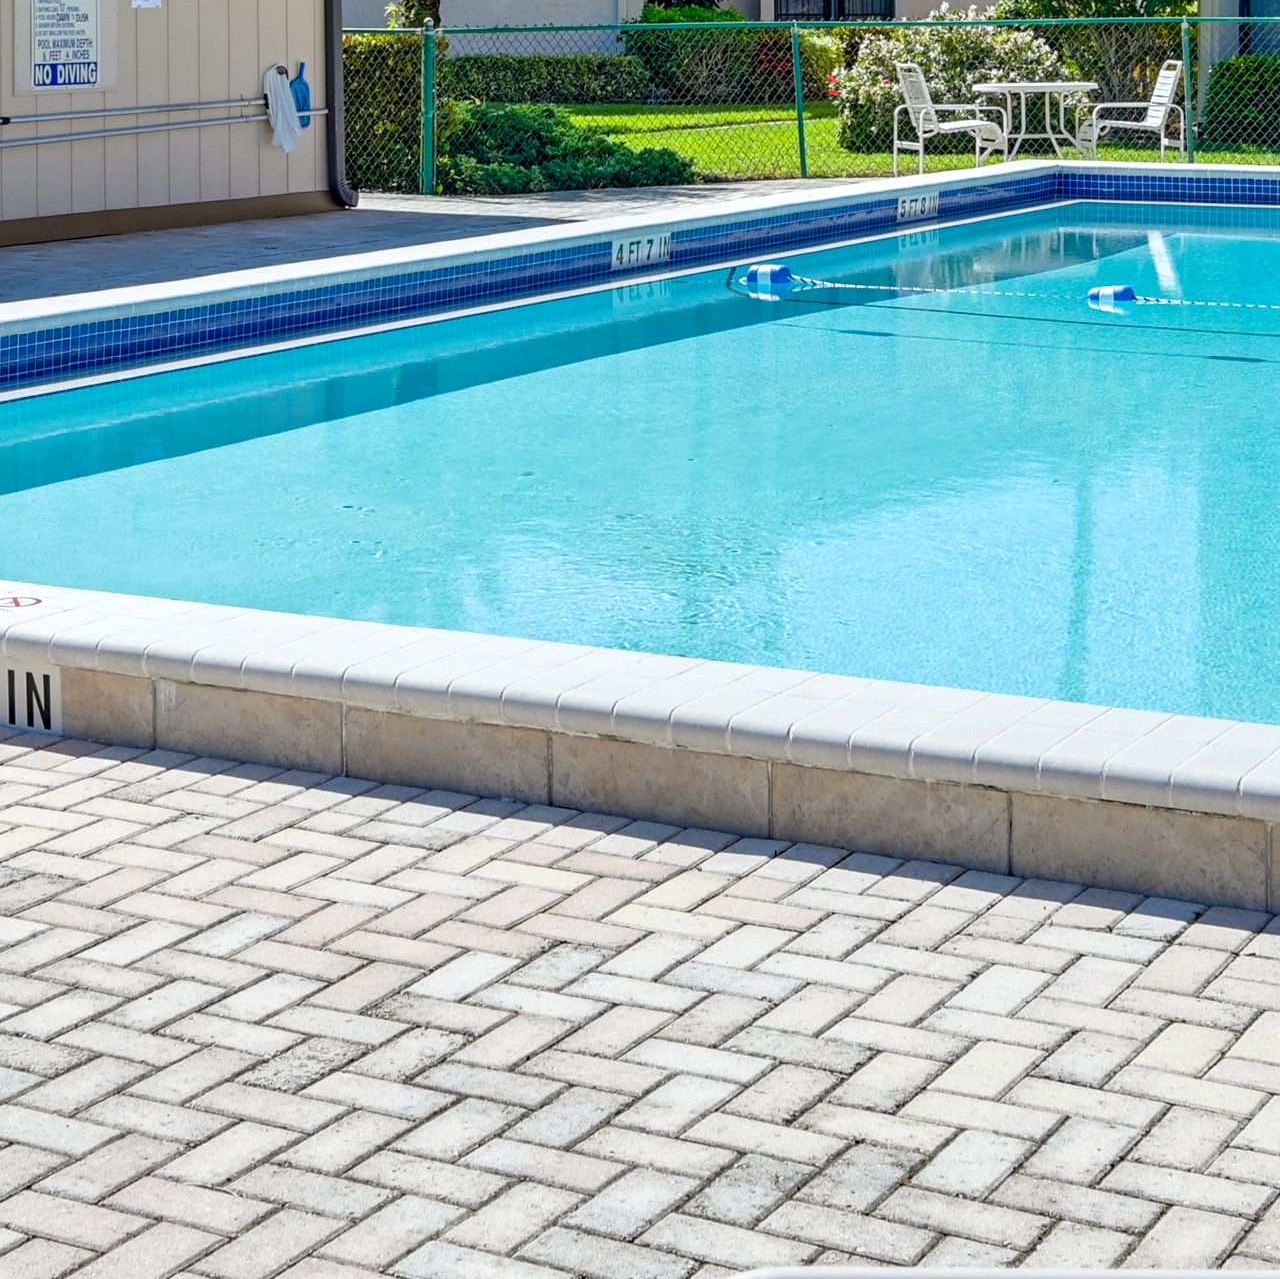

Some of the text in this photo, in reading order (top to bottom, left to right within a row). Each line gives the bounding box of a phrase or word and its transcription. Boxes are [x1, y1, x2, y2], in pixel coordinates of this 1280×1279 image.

[75, 12, 89, 22] DUSK
[37, 38, 51, 50] POOL
[51, 38, 76, 49] MAXIMUM
[49, 50, 62, 61] FEET
[71, 49, 90, 60] INCHES
[35, 62, 97, 85] NO DIVING
[900, 194, 938, 218] 5 FT 8 IN
[615, 235, 671, 265] 4 FT 7 IN
[7, 669, 52, 730] IN
